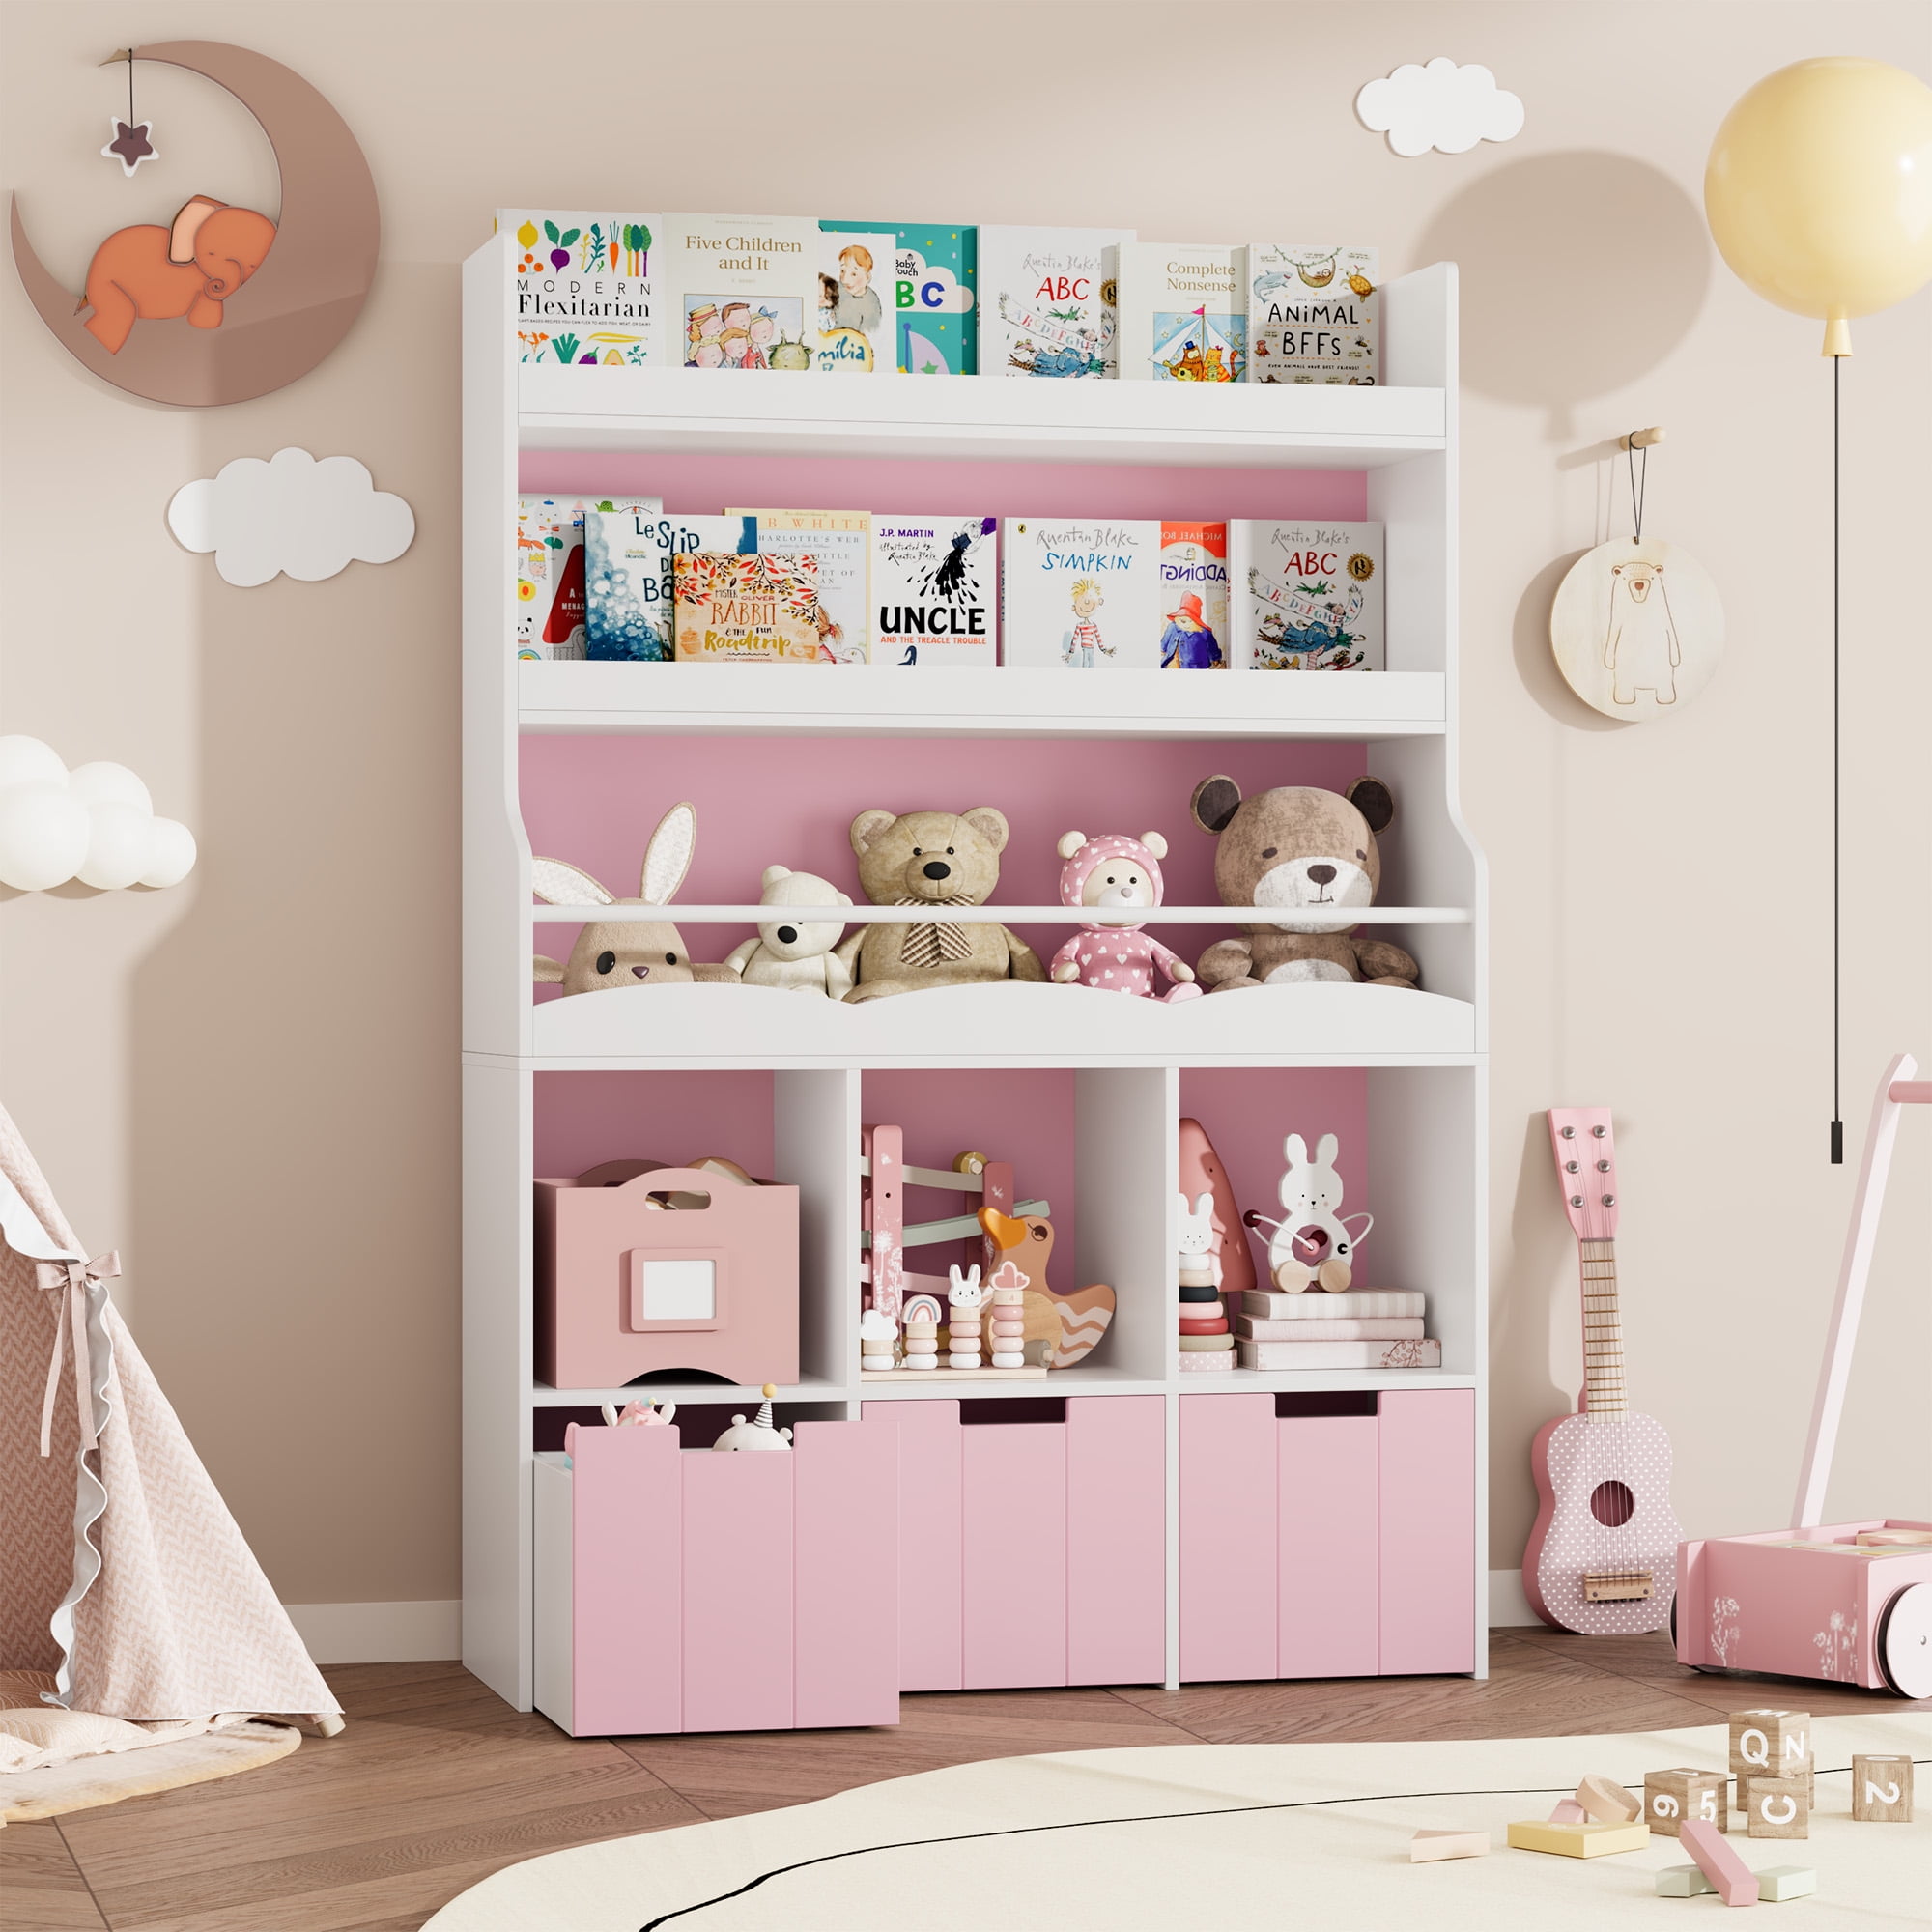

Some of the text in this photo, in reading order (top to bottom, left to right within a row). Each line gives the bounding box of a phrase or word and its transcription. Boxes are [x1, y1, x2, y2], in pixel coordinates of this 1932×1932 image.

[686, 235, 802, 253] Five Children
[719, 255, 770, 270] and It
[896, 268, 919, 277] ouch
[1166, 261, 1236, 278] Complete
[517, 278, 651, 296] MODERN
[1035, 276, 1091, 302] ABC
[1166, 277, 1236, 293] Nonsense
[518, 293, 650, 318] Flexitarian
[635, 516, 655, 539] Le
[791, 517, 868, 530] WHITE
[879, 528, 935, 538] J.P. MARTIN
[1036, 526, 1140, 551] Quentin Blake
[1270, 527, 1350, 554] Quentin Blake's
[1041, 552, 1133, 573] SIMPKIN
[1283, 551, 1339, 577] ABC
[569, 587, 576, 599] A
[715, 588, 739, 599] MISTER
[710, 599, 780, 626] RABBIT
[879, 606, 986, 635] UNCLE
[733, 628, 746, 637] THE
[755, 626, 773, 635] FUN
[880, 636, 987, 645] AND THE TREACLE TROUBLE
[703, 629, 791, 657] Roadtrip
[1740, 1728, 1770, 1768] Q
[1785, 1730, 1805, 1761] N
[1865, 1779, 1901, 1804] 2
[1699, 1789, 1717, 1824] 5
[1760, 1794, 1798, 1825] C
